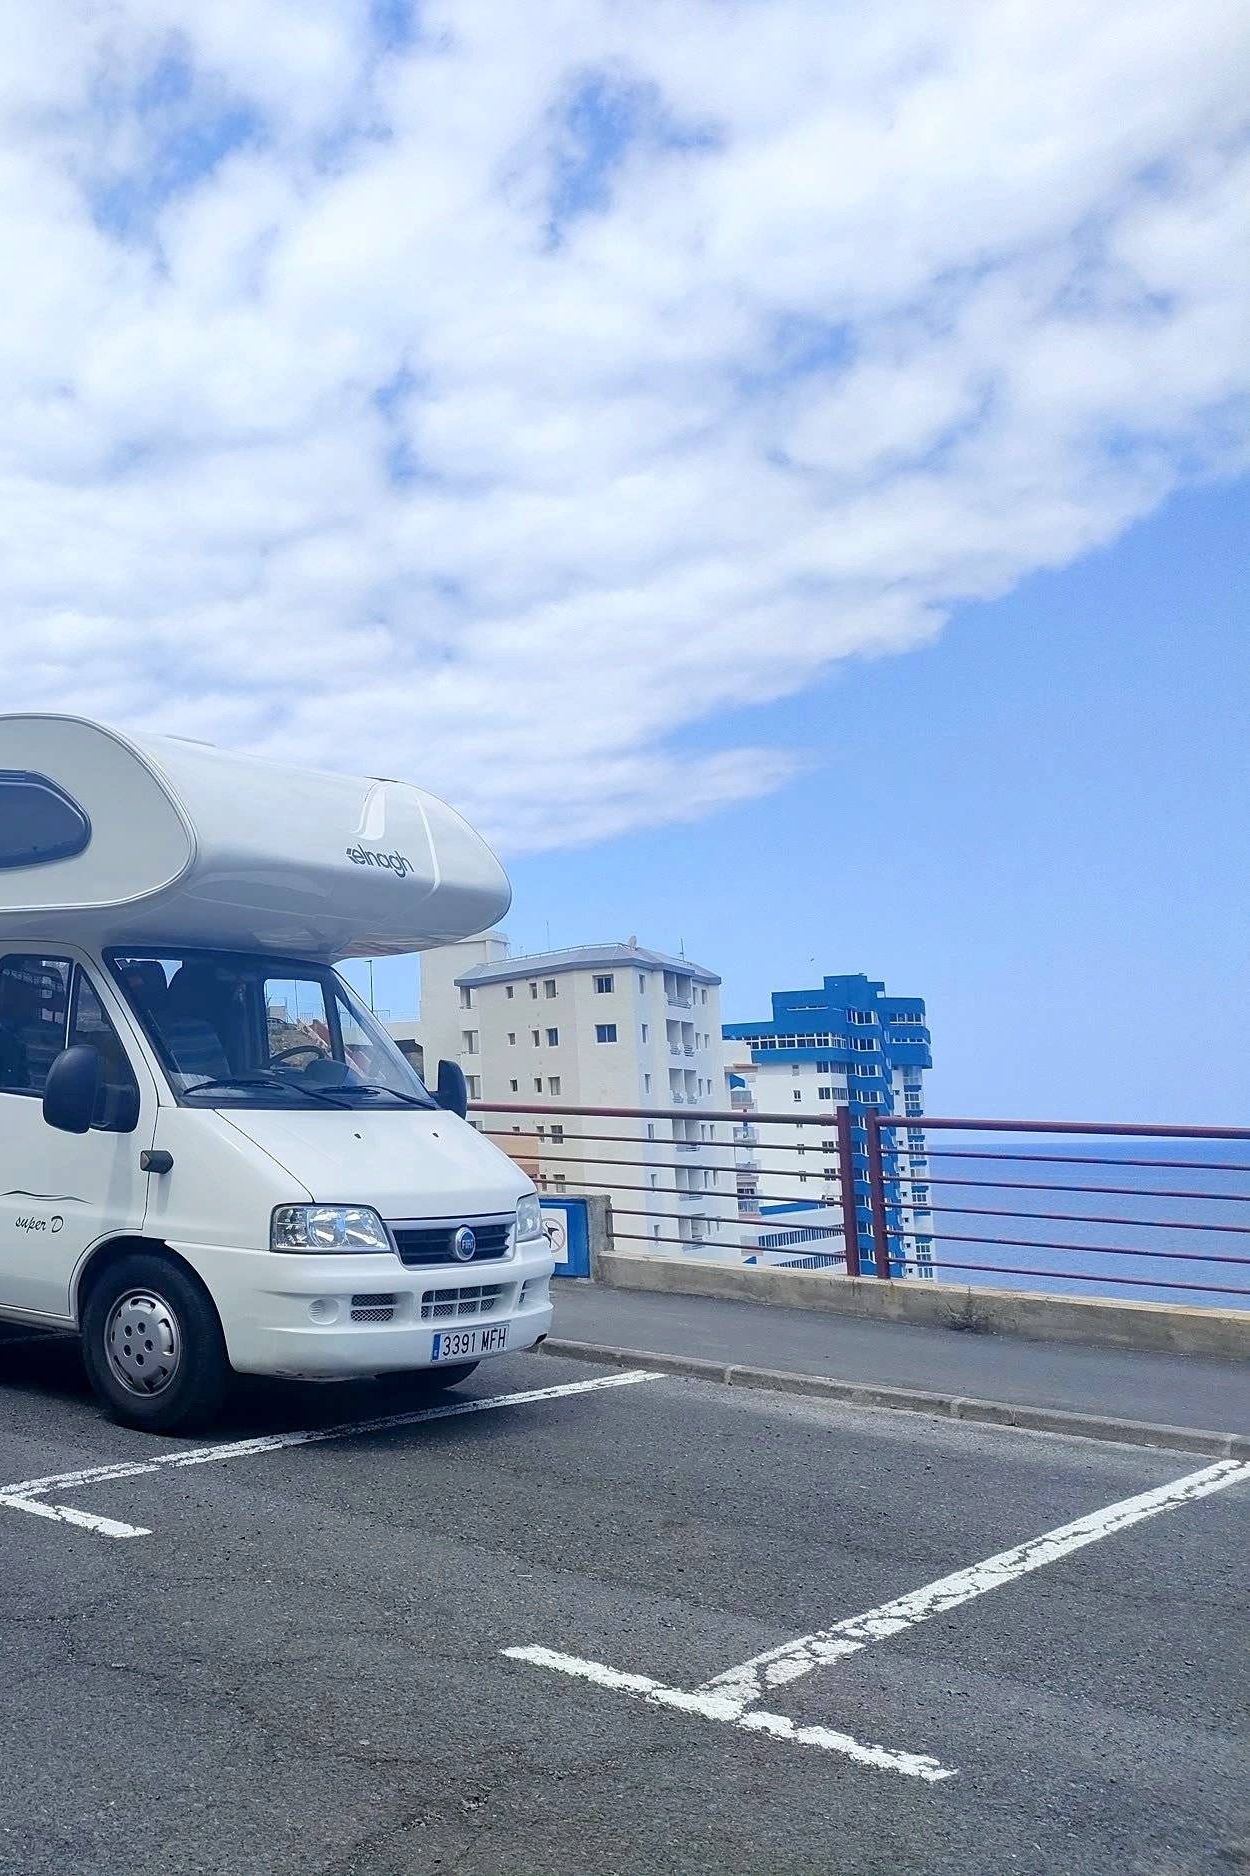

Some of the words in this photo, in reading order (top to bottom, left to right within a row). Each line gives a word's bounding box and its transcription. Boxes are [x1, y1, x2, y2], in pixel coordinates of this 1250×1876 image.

[351, 843, 415, 878] elnagh
[15, 1216, 47, 1233] super
[50, 1215, 64, 1233] D
[461, 1239, 474, 1250] FIAT
[442, 1332, 476, 1357] 3391
[481, 1327, 507, 1352] MFH
